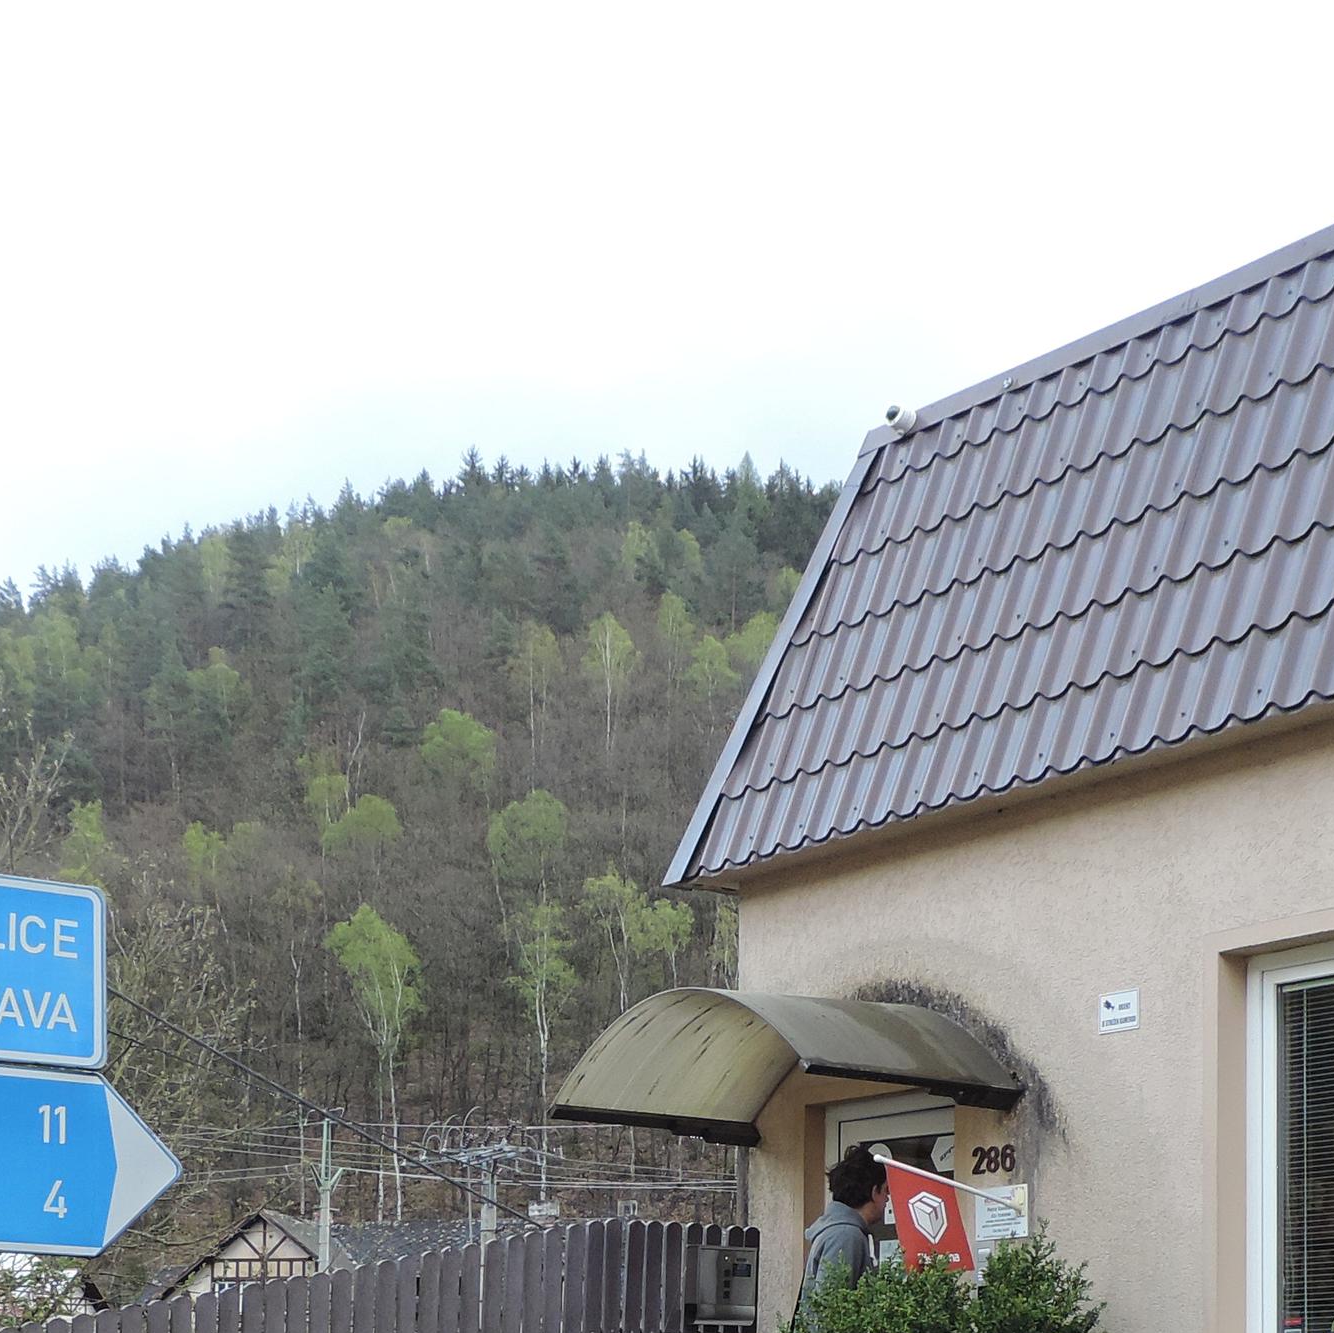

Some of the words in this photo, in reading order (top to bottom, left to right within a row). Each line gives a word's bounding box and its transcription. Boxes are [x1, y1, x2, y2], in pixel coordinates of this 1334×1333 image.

[38, 1105, 67, 1145] 11
[972, 1144, 1016, 1175] 286
[43, 1180, 68, 1219] 4
